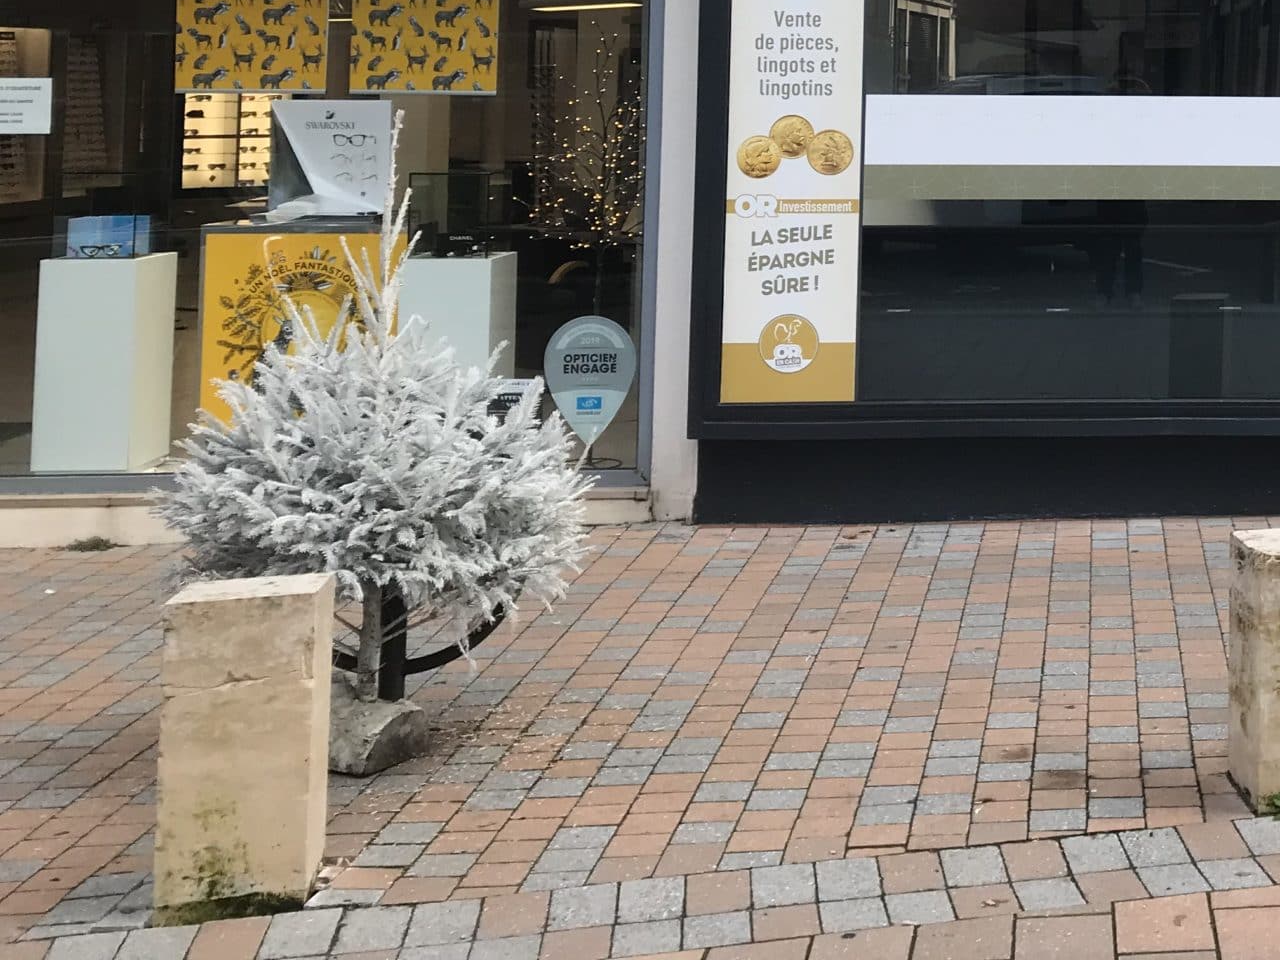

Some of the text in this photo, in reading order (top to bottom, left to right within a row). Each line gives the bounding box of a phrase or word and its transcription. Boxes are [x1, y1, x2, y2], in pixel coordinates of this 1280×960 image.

[774, 10, 822, 27] Vente
[755, 33, 839, 54] de pièces,
[757, 56, 836, 76] lingots et
[759, 79, 833, 100] lingotins
[305, 121, 355, 130] SWAROVSKI
[735, 194, 852, 218] OR Investissement
[751, 224, 833, 246] LA SEULE
[748, 249, 835, 272] ÉPARGNE
[761, 274, 819, 296] SÛRE !
[563, 353, 617, 363] OPTICIEN
